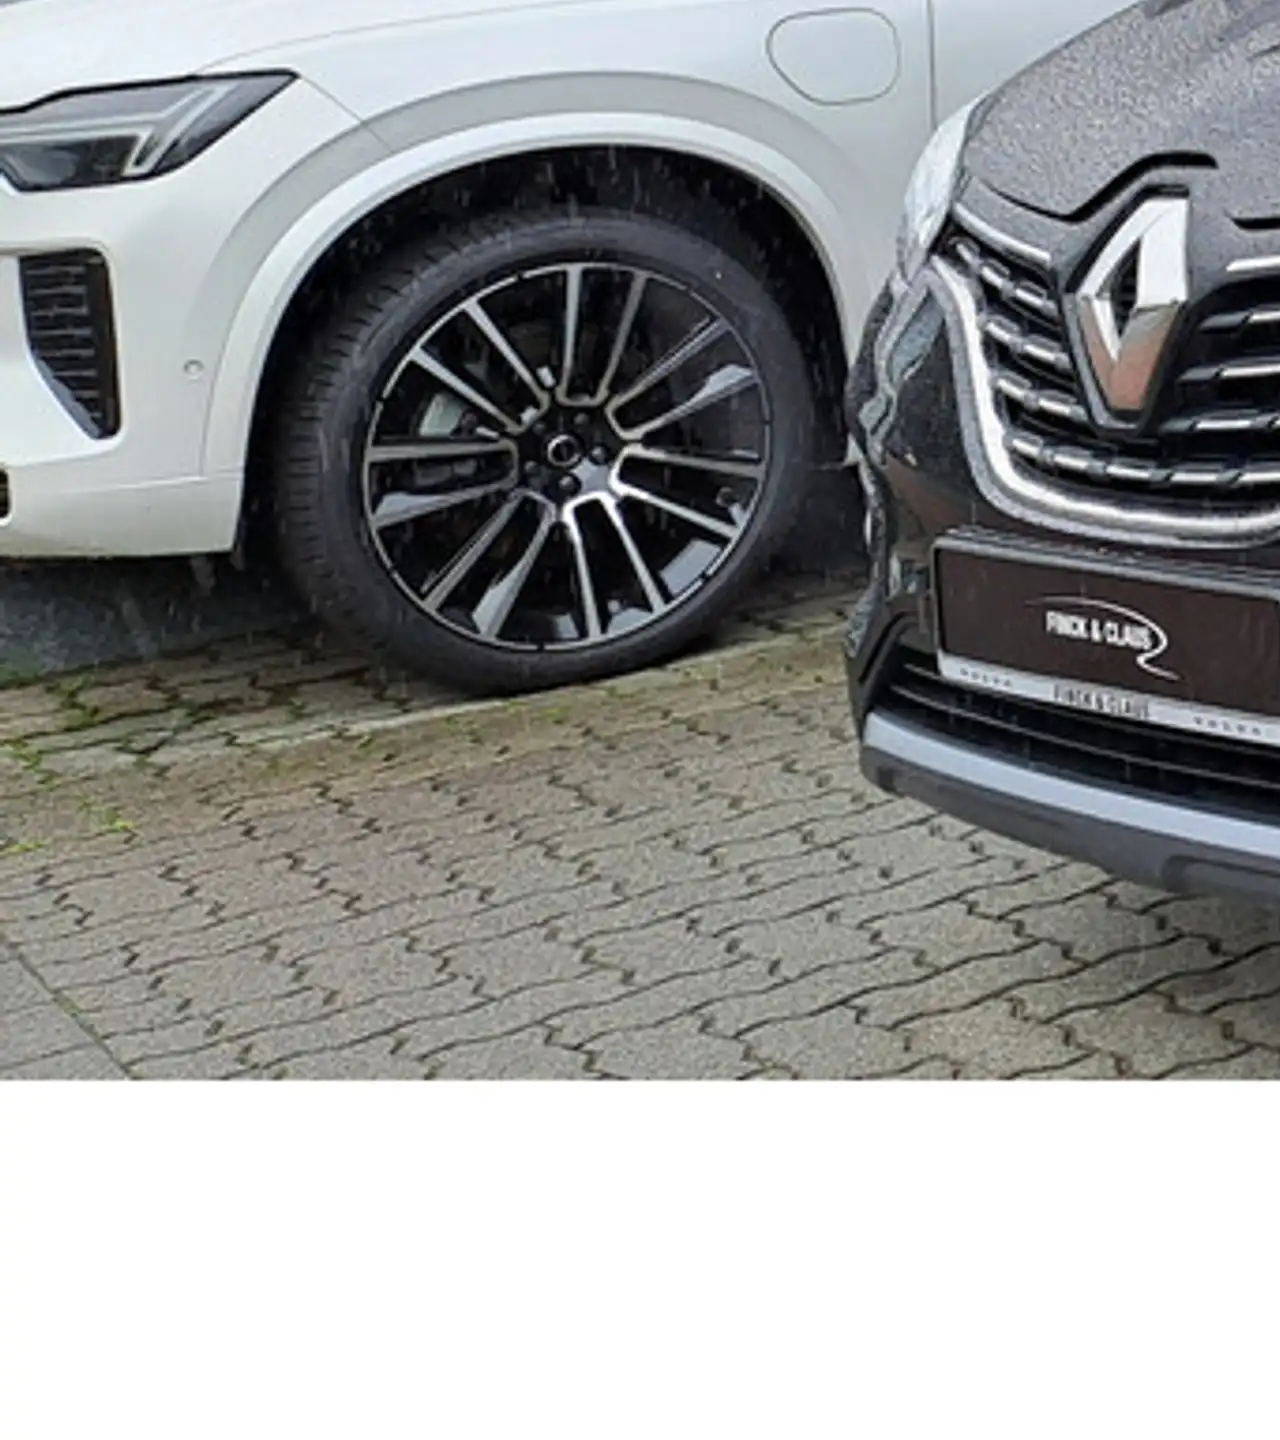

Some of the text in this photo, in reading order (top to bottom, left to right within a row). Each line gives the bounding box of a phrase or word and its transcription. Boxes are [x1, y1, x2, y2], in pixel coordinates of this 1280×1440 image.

[1046, 610, 1152, 651] FINCK & CLAUS
[1109, 694, 1150, 720] CLAUS
